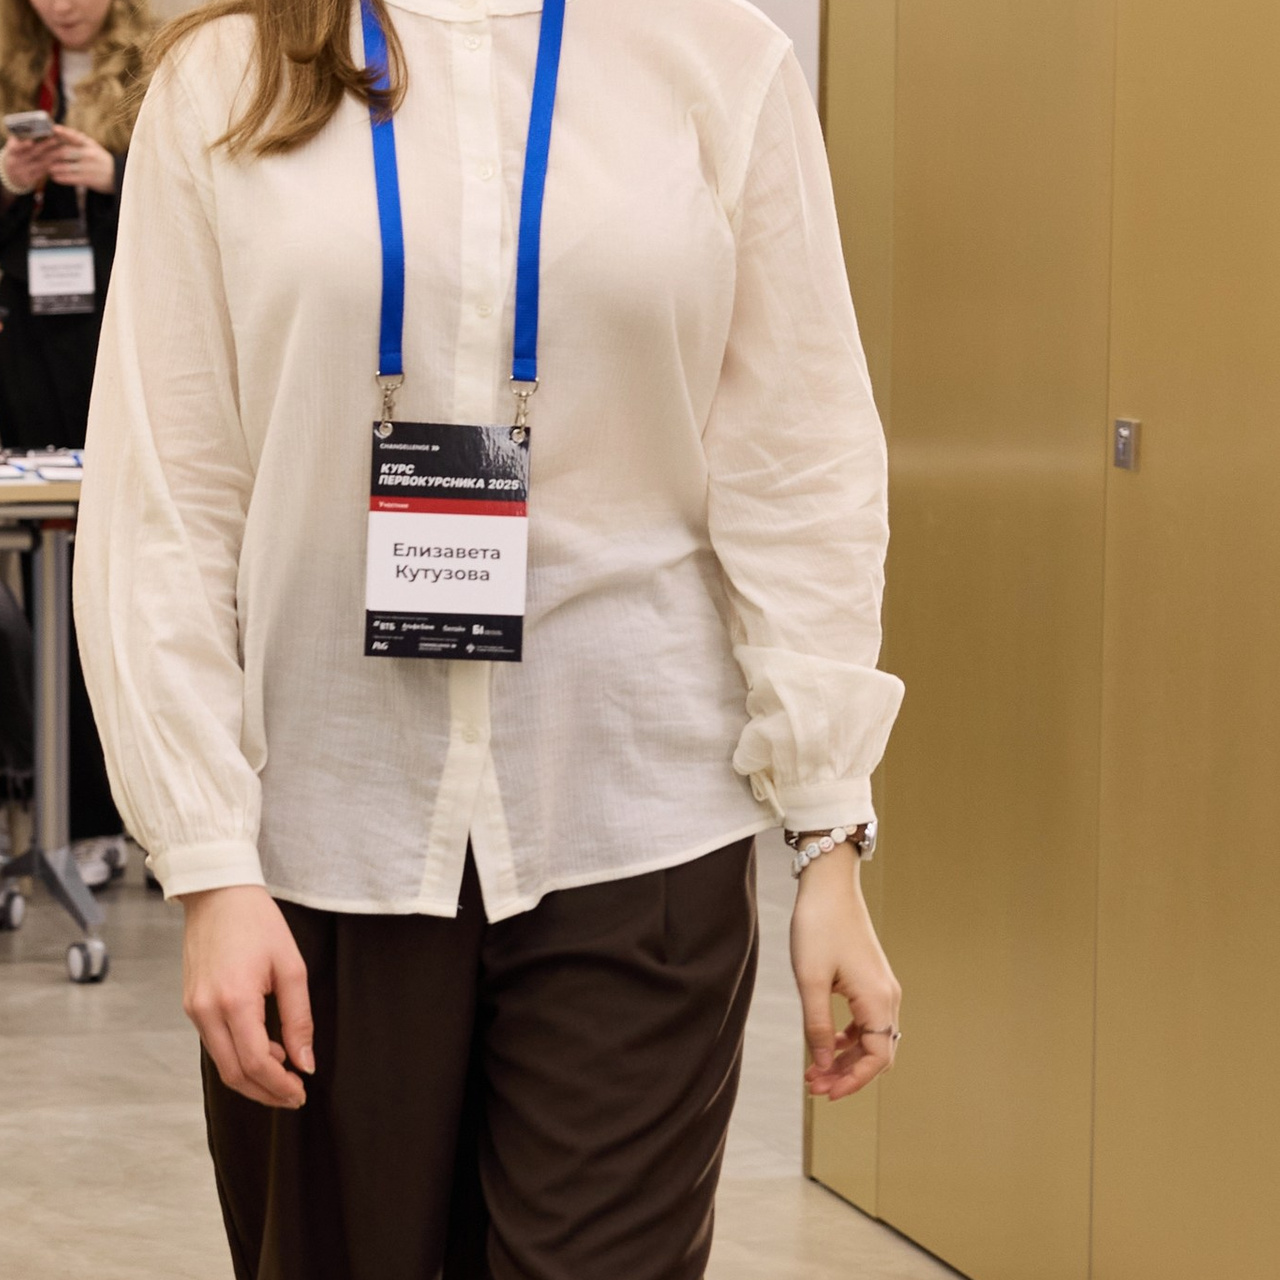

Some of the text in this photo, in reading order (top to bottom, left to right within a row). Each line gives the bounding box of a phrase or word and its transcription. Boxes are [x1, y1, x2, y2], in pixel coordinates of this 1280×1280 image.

[380, 463, 416, 475] КУРС
[378, 474, 520, 491] ПЕРВОКУРСНИКА 2025
[393, 542, 501, 560] Елизавета
[395, 564, 491, 583] Кутузова
